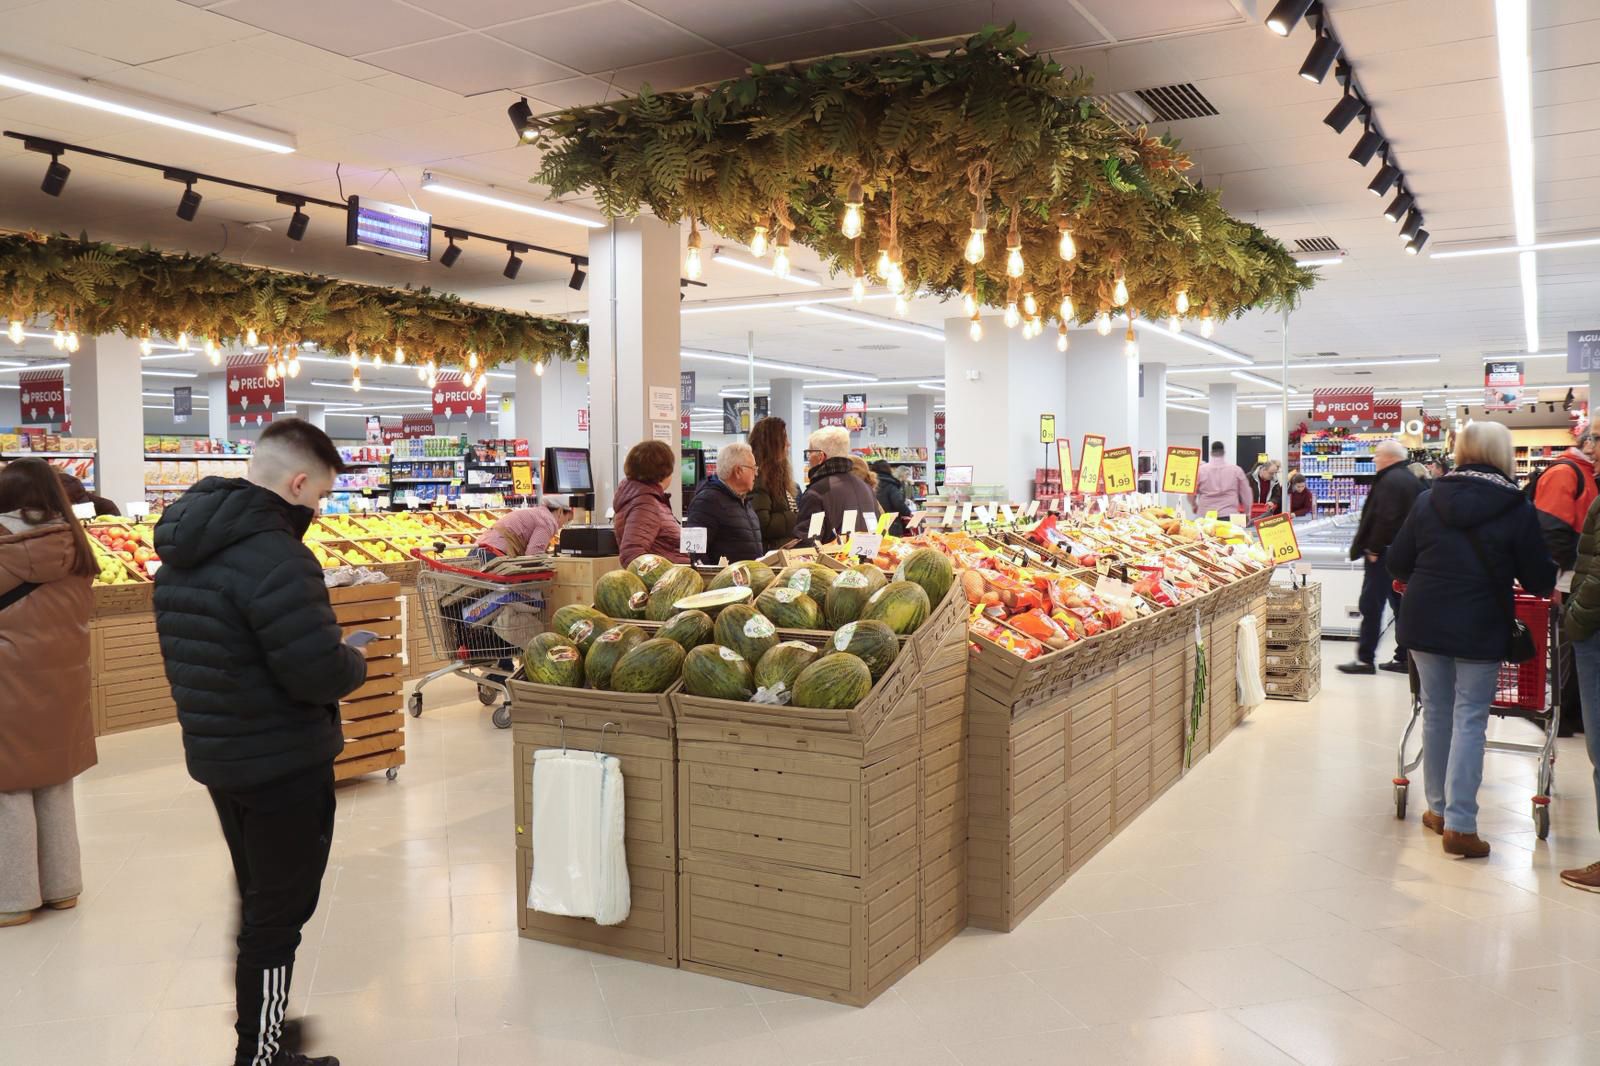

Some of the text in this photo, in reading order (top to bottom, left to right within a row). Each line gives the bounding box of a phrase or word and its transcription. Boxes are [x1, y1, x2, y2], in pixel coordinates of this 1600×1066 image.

[240, 377, 281, 391] PRECIOS
[31, 391, 63, 403] PRECIOS
[445, 391, 482, 402] PRECIOS
[1328, 402, 1369, 411] PRECIOS
[1373, 412, 1398, 420] ECIOS
[411, 425, 433, 433] PRECIOS
